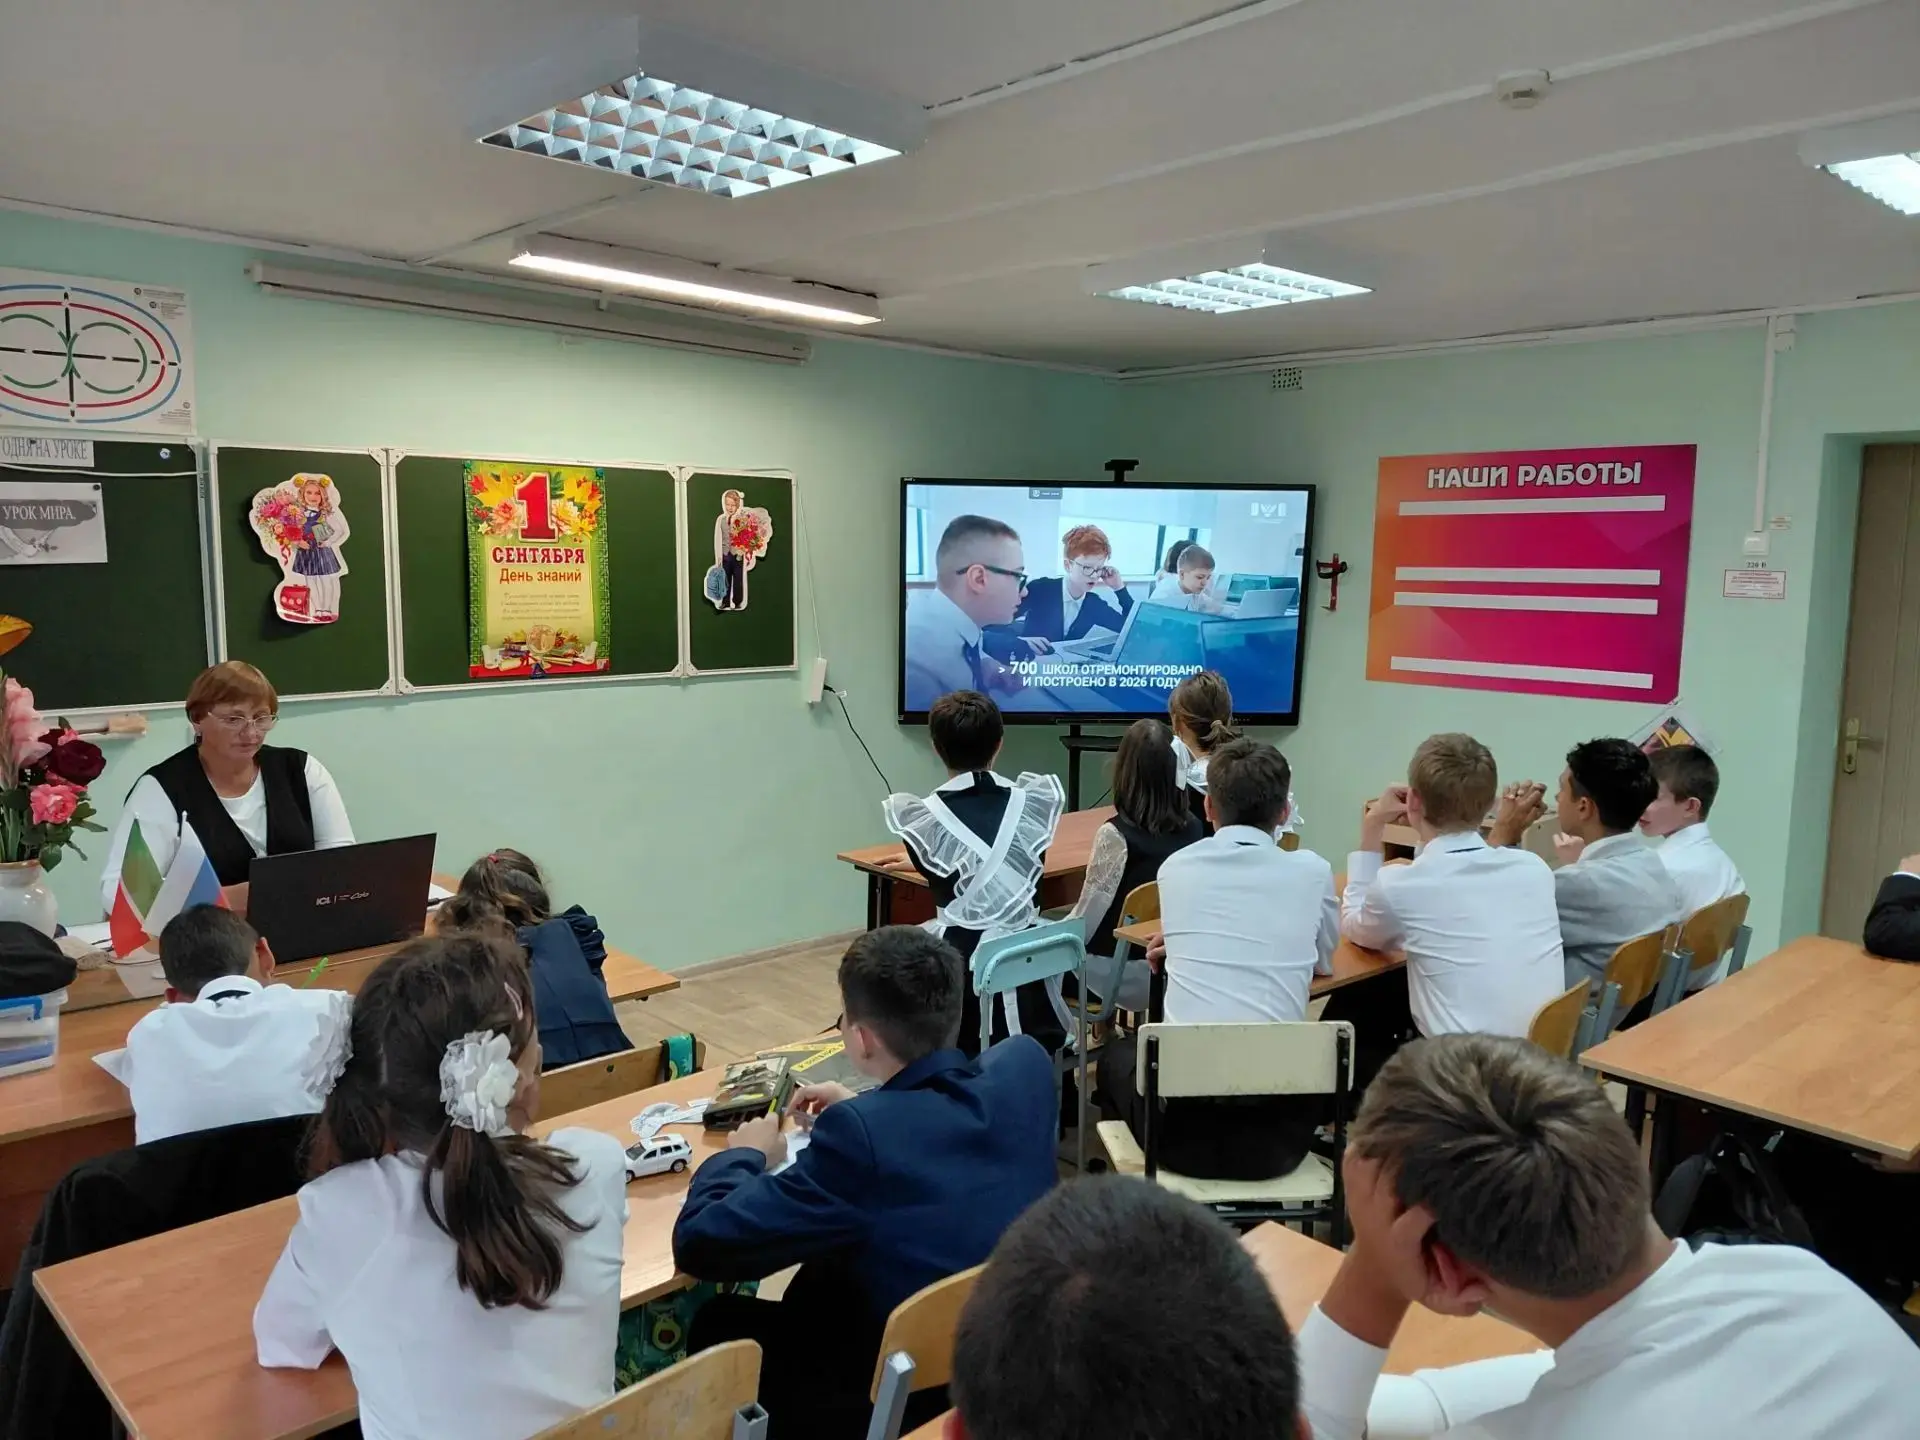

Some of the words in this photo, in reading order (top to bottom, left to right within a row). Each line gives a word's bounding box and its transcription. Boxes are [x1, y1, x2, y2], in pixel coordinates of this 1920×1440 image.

[0, 436, 33, 460] ОДНЯ
[35, 438, 51, 457] НА
[52, 439, 88, 460] УРОКЕ
[1427, 466, 1509, 488] НАШИ
[1517, 462, 1642, 486] РАБОТЫ
[2, 505, 37, 520] УРОК
[39, 505, 77, 520] МИРА.
[516, 473, 558, 541] 1
[492, 546, 585, 564] СЕНТЯБРЯ
[500, 568, 534, 584] День
[537, 568, 582, 582] знаний
[1009, 661, 1037, 675] 700
[1042, 664, 1079, 675] ШКОЛ
[1081, 664, 1203, 675] ОТРЕМОНТИРОВАНО
[1022, 677, 1031, 687] И
[1034, 677, 1106, 687] ПОСТРОЕНО
[1109, 677, 1117, 687] В
[1120, 677, 1147, 687] 2026
[1150, 677, 1181, 689] ГОДУ
